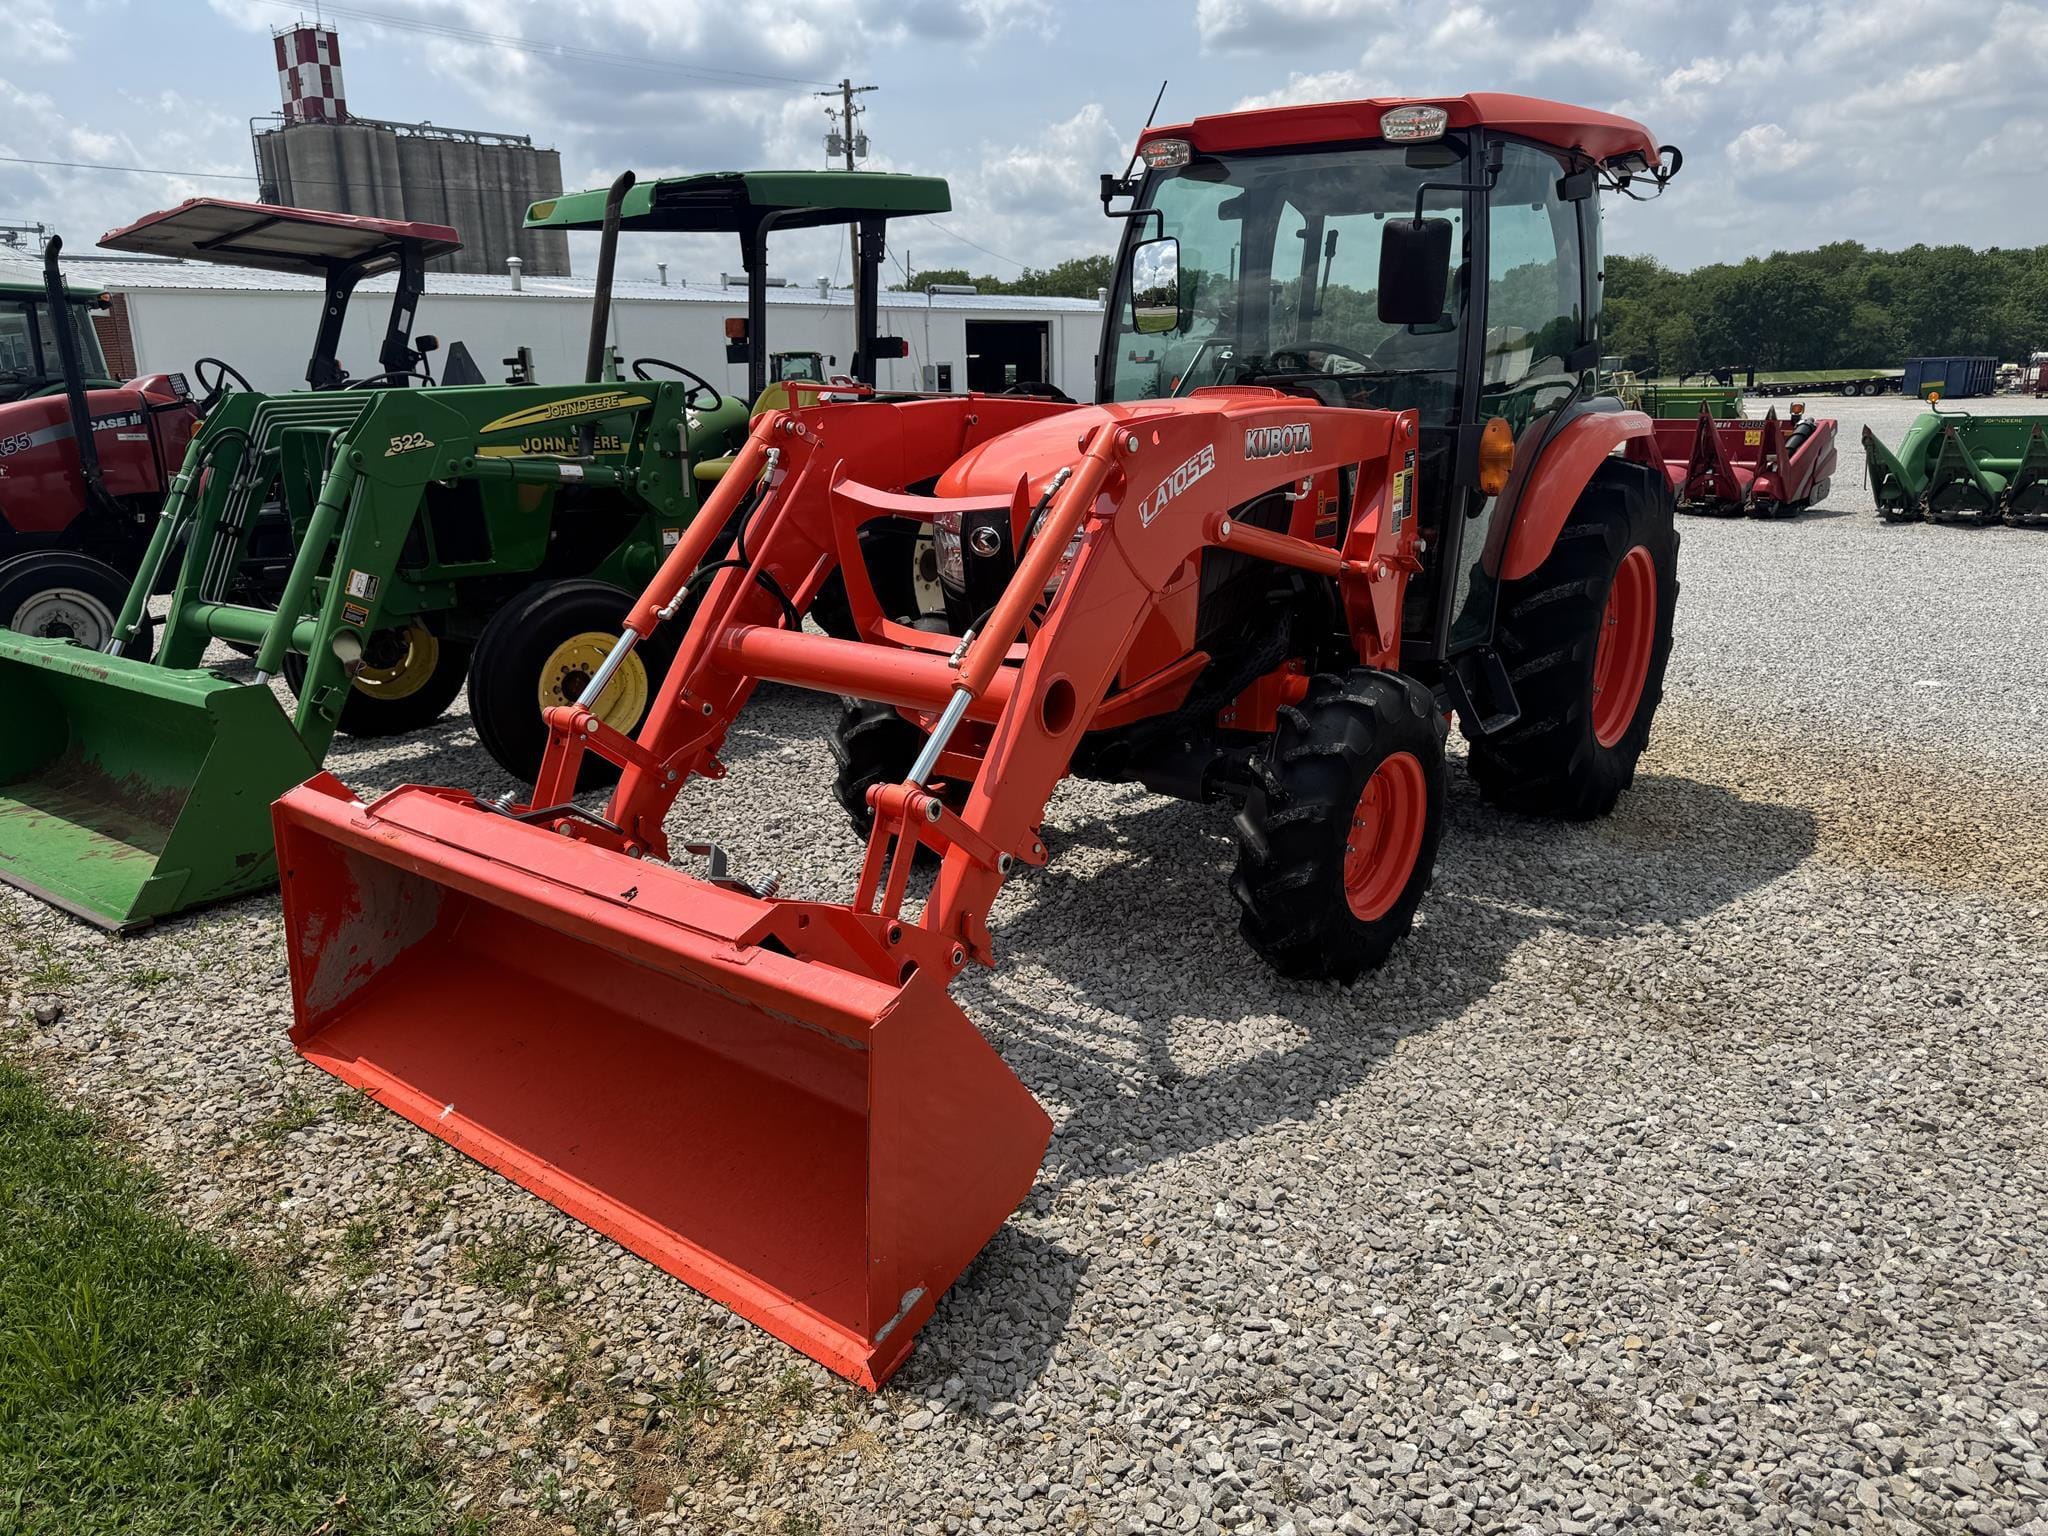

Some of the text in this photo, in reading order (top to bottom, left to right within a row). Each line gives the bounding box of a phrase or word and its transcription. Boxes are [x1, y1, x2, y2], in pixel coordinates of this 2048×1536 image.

[545, 395, 620, 418] JOHN DEERE
[390, 431, 426, 452] 522
[521, 435, 621, 452] JOHN DERE
[1245, 423, 1312, 461] KUBOTA
[1140, 445, 1215, 525] LA1055
